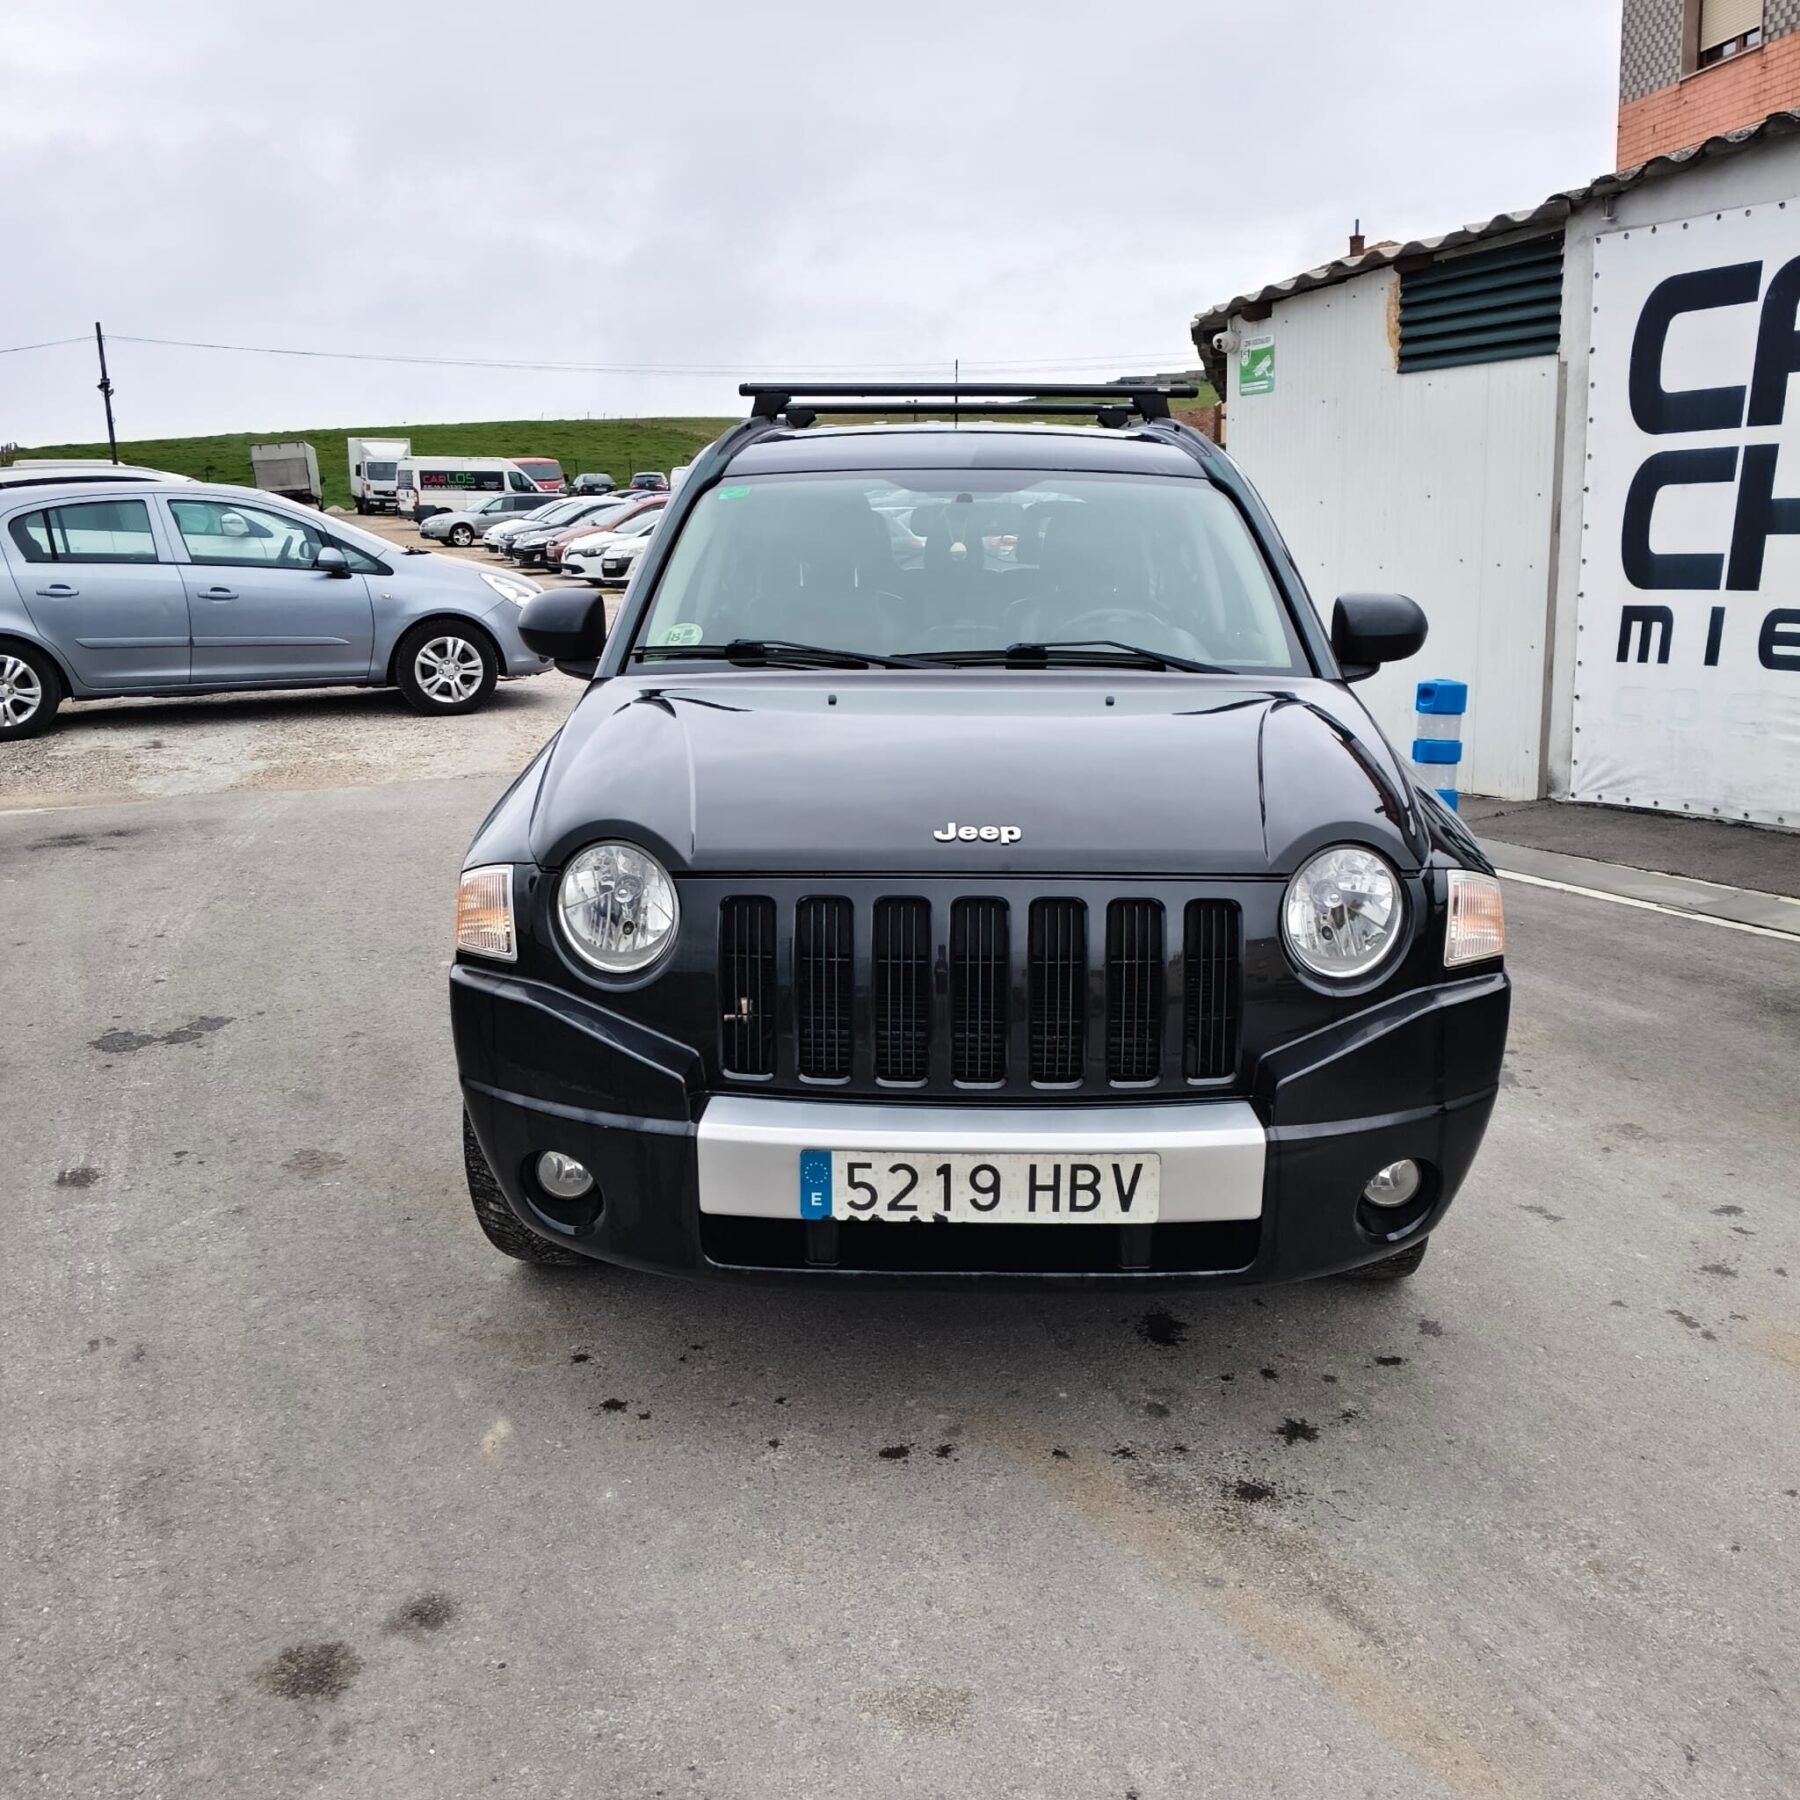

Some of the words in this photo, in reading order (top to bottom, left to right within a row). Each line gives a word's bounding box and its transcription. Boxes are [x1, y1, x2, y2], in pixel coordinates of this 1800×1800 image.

[423, 472, 475, 484] CARLOS
[1621, 443, 1800, 592] CH
[933, 822, 1022, 846] Jeep
[811, 1192, 822, 1206] E
[846, 1162, 1001, 1212] 5219
[1028, 1163, 1143, 1213] HBV
